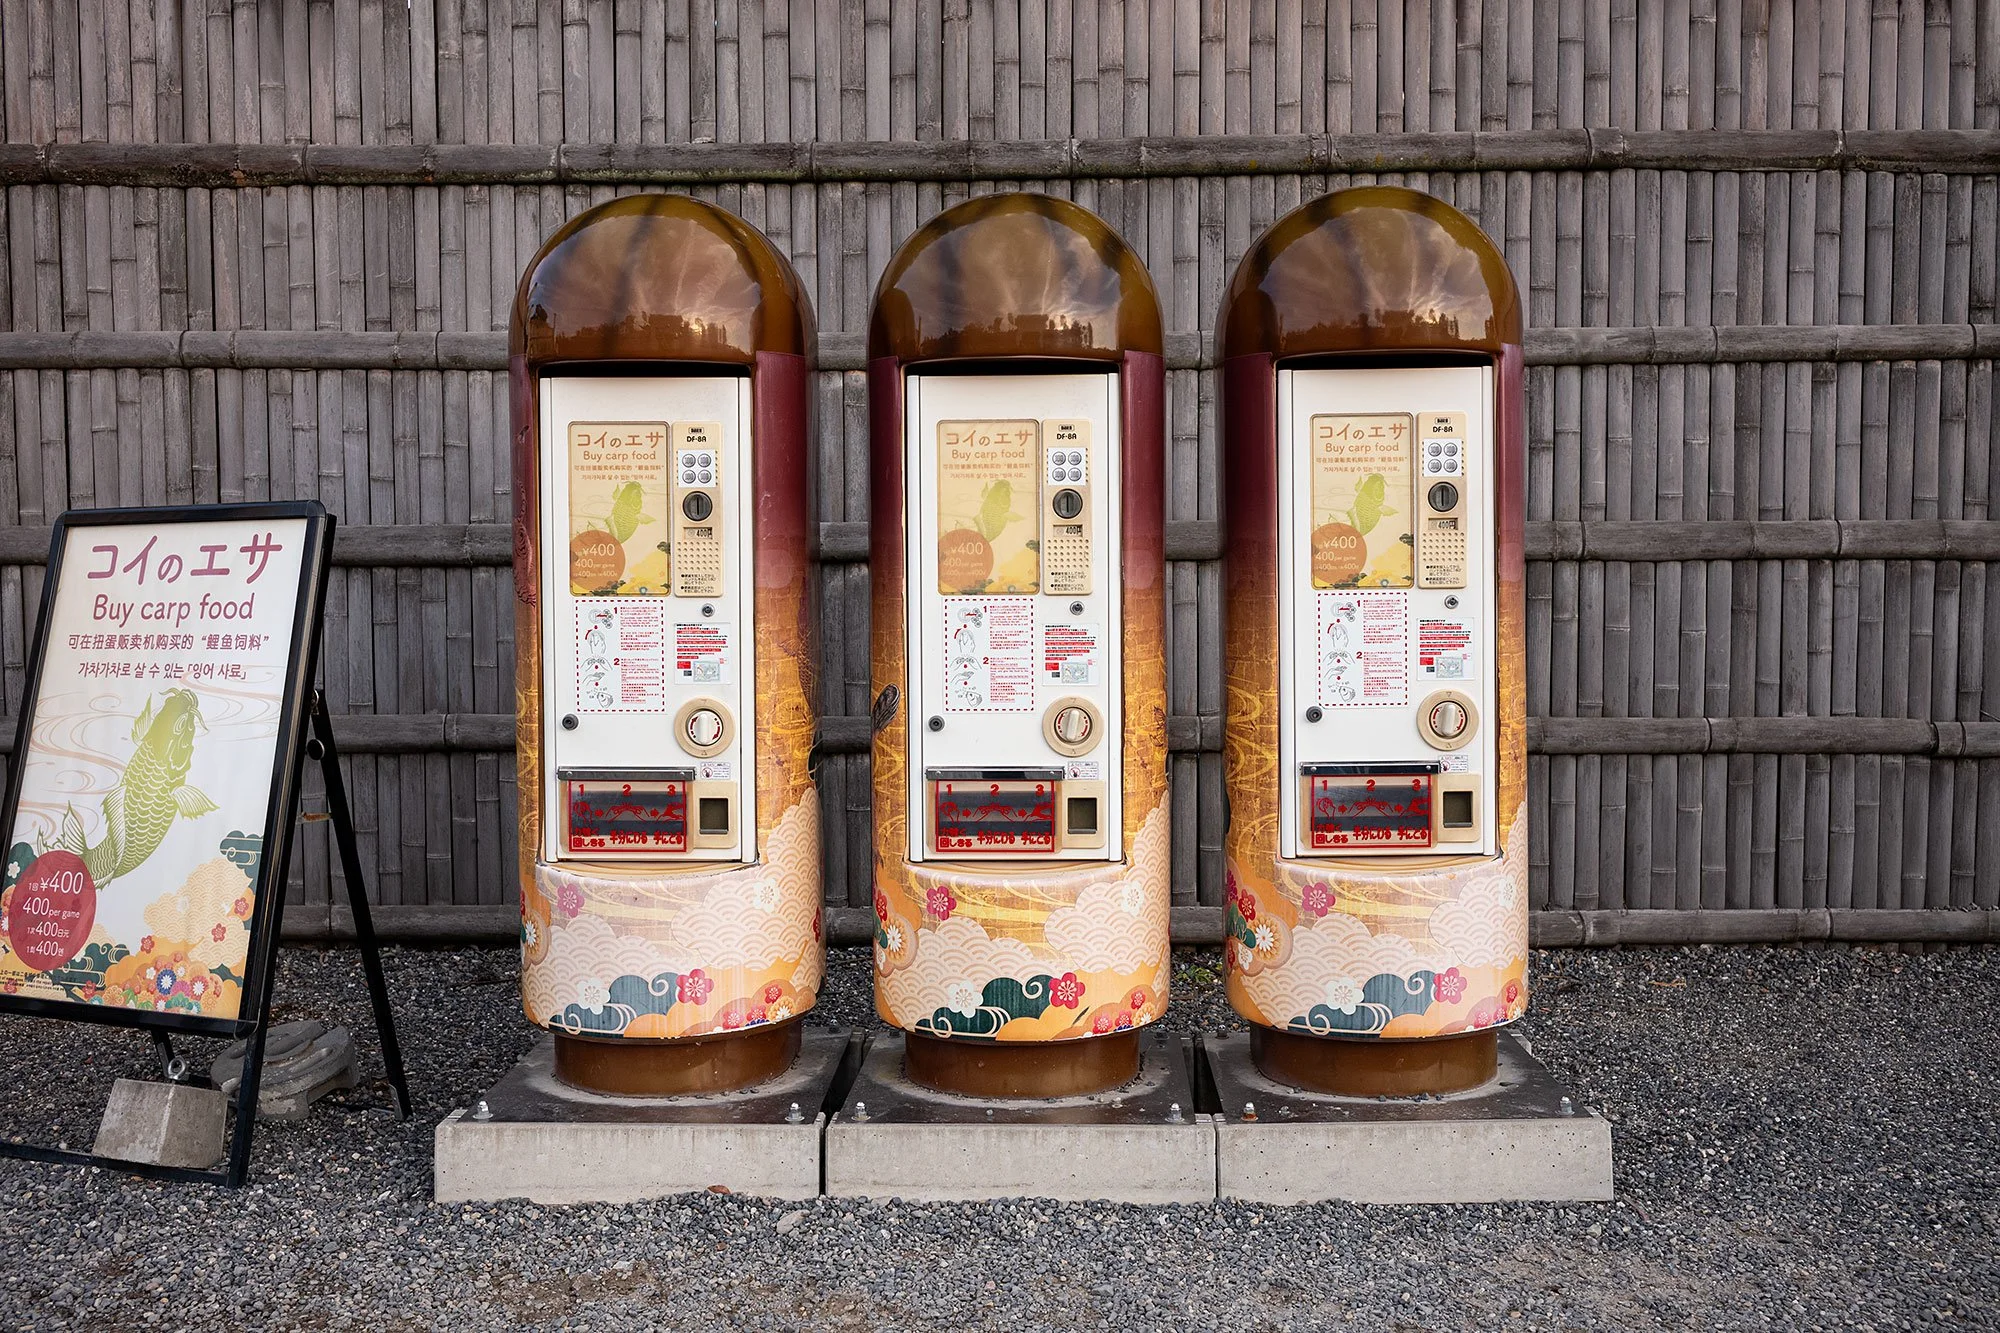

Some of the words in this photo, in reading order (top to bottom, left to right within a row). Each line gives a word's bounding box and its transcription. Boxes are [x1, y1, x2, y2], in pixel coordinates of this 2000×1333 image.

[946, 429, 1033, 447] コイのエサ
[1319, 423, 1407, 440] コイのエサ
[577, 431, 664, 449] コイのエサ
[686, 435, 707, 443] DF-8A
[952, 450, 971, 461] Buy
[974, 451, 997, 461] carp
[1001, 449, 1024, 458] food
[1325, 443, 1344, 454] Buy
[1348, 444, 1371, 454] carp
[1375, 442, 1399, 452] food
[583, 452, 602, 462] Buy
[605, 453, 628, 463] carp
[632, 451, 656, 460] food
[87, 532, 282, 585] コイのエサ
[93, 594, 134, 628] Buy
[140, 600, 190, 628] carp
[199, 592, 255, 621] food
[78, 662, 131, 679] 가차가차로
[134, 662, 147, 679] 살
[148, 662, 161, 679] 수
[163, 663, 184, 679] 있는
[578, 784, 585, 796] 1
[622, 784, 632, 796] 2
[667, 784, 676, 796] 3
[946, 784, 952, 796] 1
[990, 784, 1000, 796] 2
[1036, 784, 1044, 796] 3
[1322, 780, 1328, 791] 1
[1366, 780, 1375, 791] 2
[1412, 780, 1421, 791] 3
[653, 830, 682, 845] 手にとる
[1021, 830, 1050, 845] 手にとる
[1397, 826, 1428, 840] 手にとる
[62, 910, 81, 920] game
